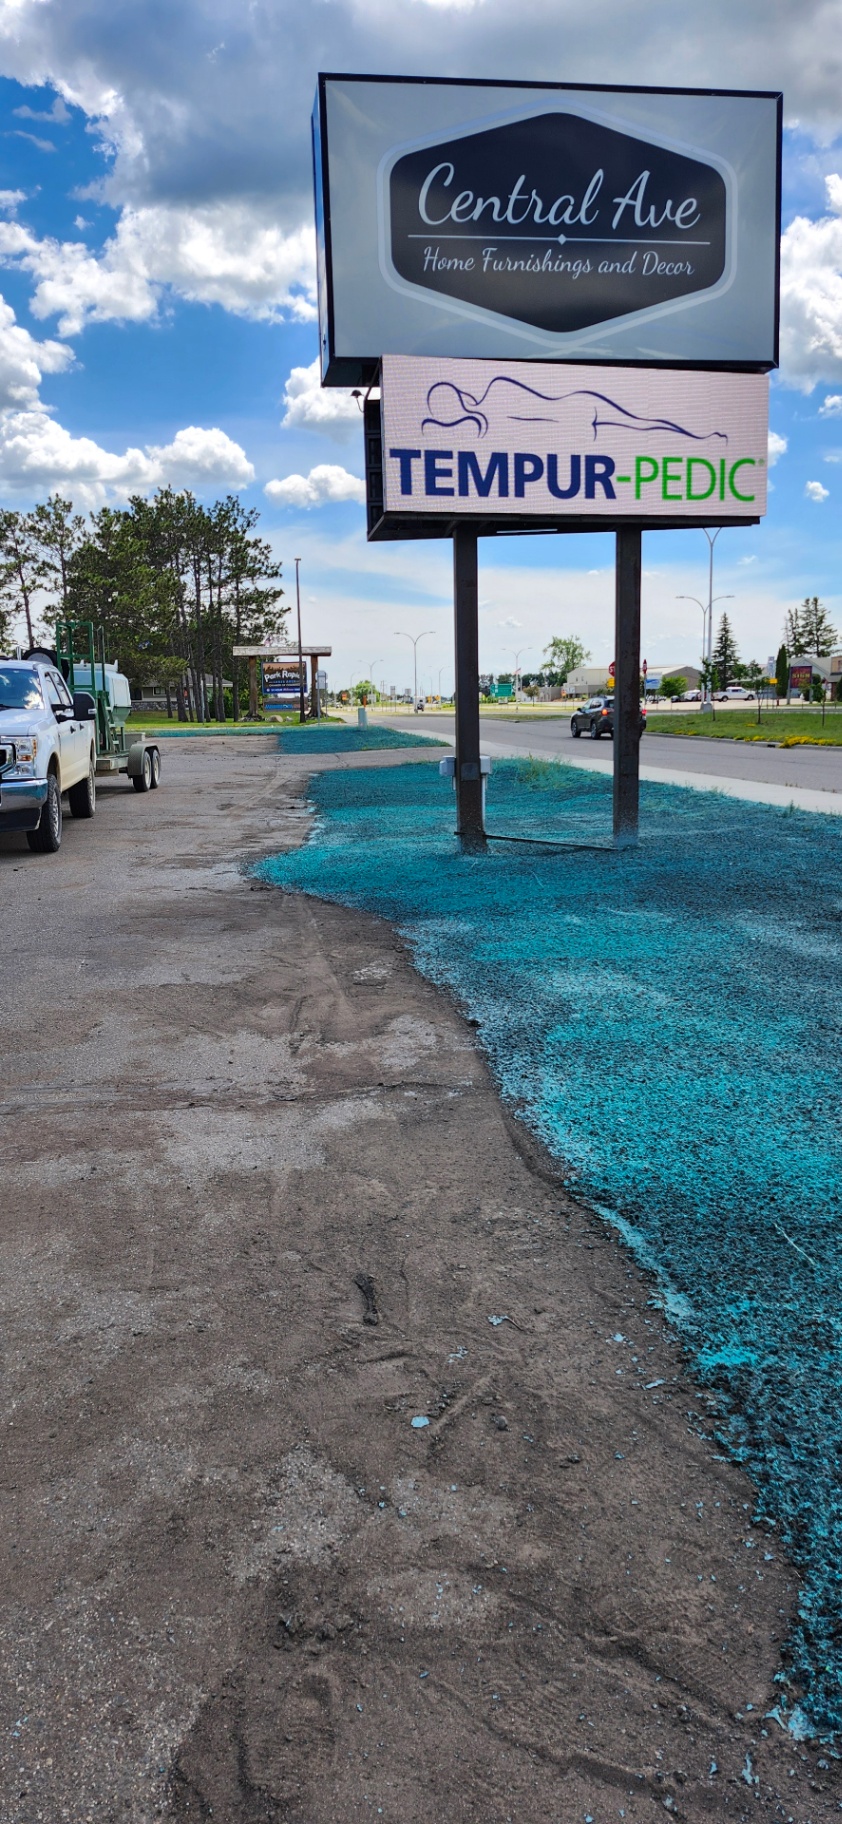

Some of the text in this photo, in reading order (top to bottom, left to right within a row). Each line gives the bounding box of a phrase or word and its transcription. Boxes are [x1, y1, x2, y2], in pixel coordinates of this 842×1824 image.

[418, 162, 701, 230] Central Ave
[422, 246, 695, 280] Home Furnishings and Decor
[389, 448, 756, 502] TEMPUR-PEDIC
[264, 671, 281, 683] Park
